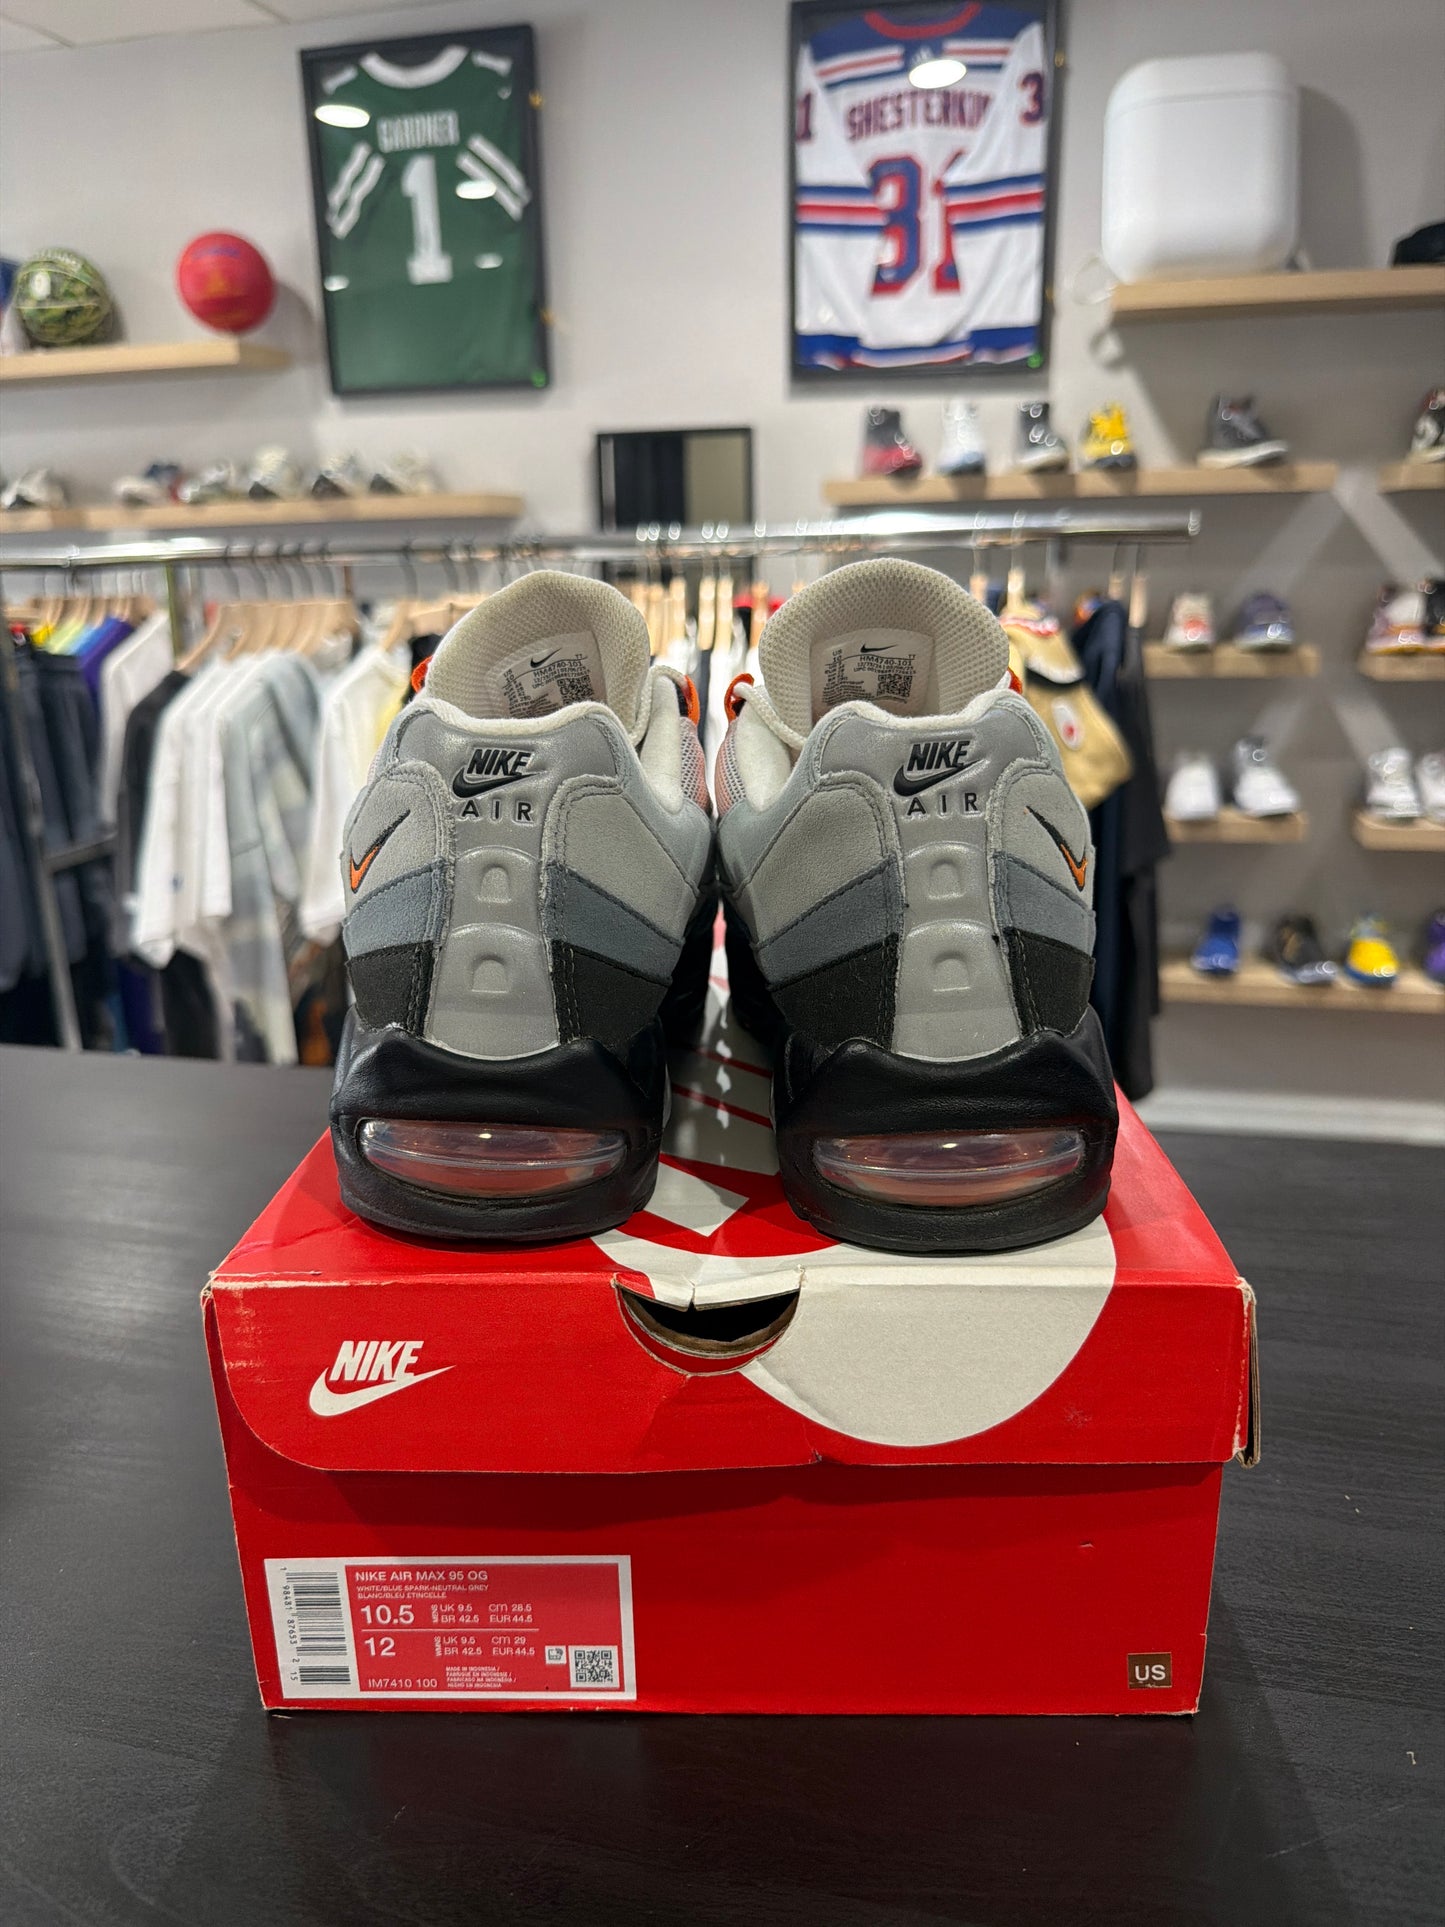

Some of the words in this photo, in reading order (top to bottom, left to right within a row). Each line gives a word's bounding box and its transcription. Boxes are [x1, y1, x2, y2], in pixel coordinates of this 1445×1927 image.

[401, 153, 453, 285] 1
[860, 655, 912, 667] HM4740-101
[532, 660, 583, 678] HM4740-101
[906, 740, 971, 771] NIKE
[466, 748, 533, 777] NIKE
[906, 792, 979, 816] AIR
[461, 799, 533, 821] AIR
[329, 1340, 425, 1382] NIKE
[355, 1571, 387, 1582] NIKE
[390, 1571, 413, 1582] AIR
[416, 1571, 445, 1581] MAX
[449, 1571, 464, 1581] 95
[467, 1571, 489, 1581] OG
[356, 1584, 402, 1592] WHITE/BLUE
[404, 1584, 468, 1592] SPARK-NEUTRAL
[440, 1604, 455, 1612] UK
[457, 1604, 473, 1612] 9.5
[511, 1604, 532, 1612] 28.5
[361, 1604, 415, 1625] 10.5
[441, 1614, 456, 1623] BR
[459, 1614, 480, 1623] 42.5
[489, 1614, 511, 1623] EUR
[512, 1614, 533, 1623] 44.5
[443, 1636, 458, 1644] UK
[460, 1636, 476, 1644] 9.5
[513, 1636, 526, 1644] 29
[364, 1636, 396, 1656] 12
[444, 1647, 459, 1656] BR
[462, 1647, 483, 1656] 42.5
[492, 1647, 514, 1656] EUR
[515, 1647, 535, 1656] 44.5
[1135, 1664, 1166, 1681] US
[368, 1678, 412, 1688] IM7410
[416, 1678, 438, 1688] 100
